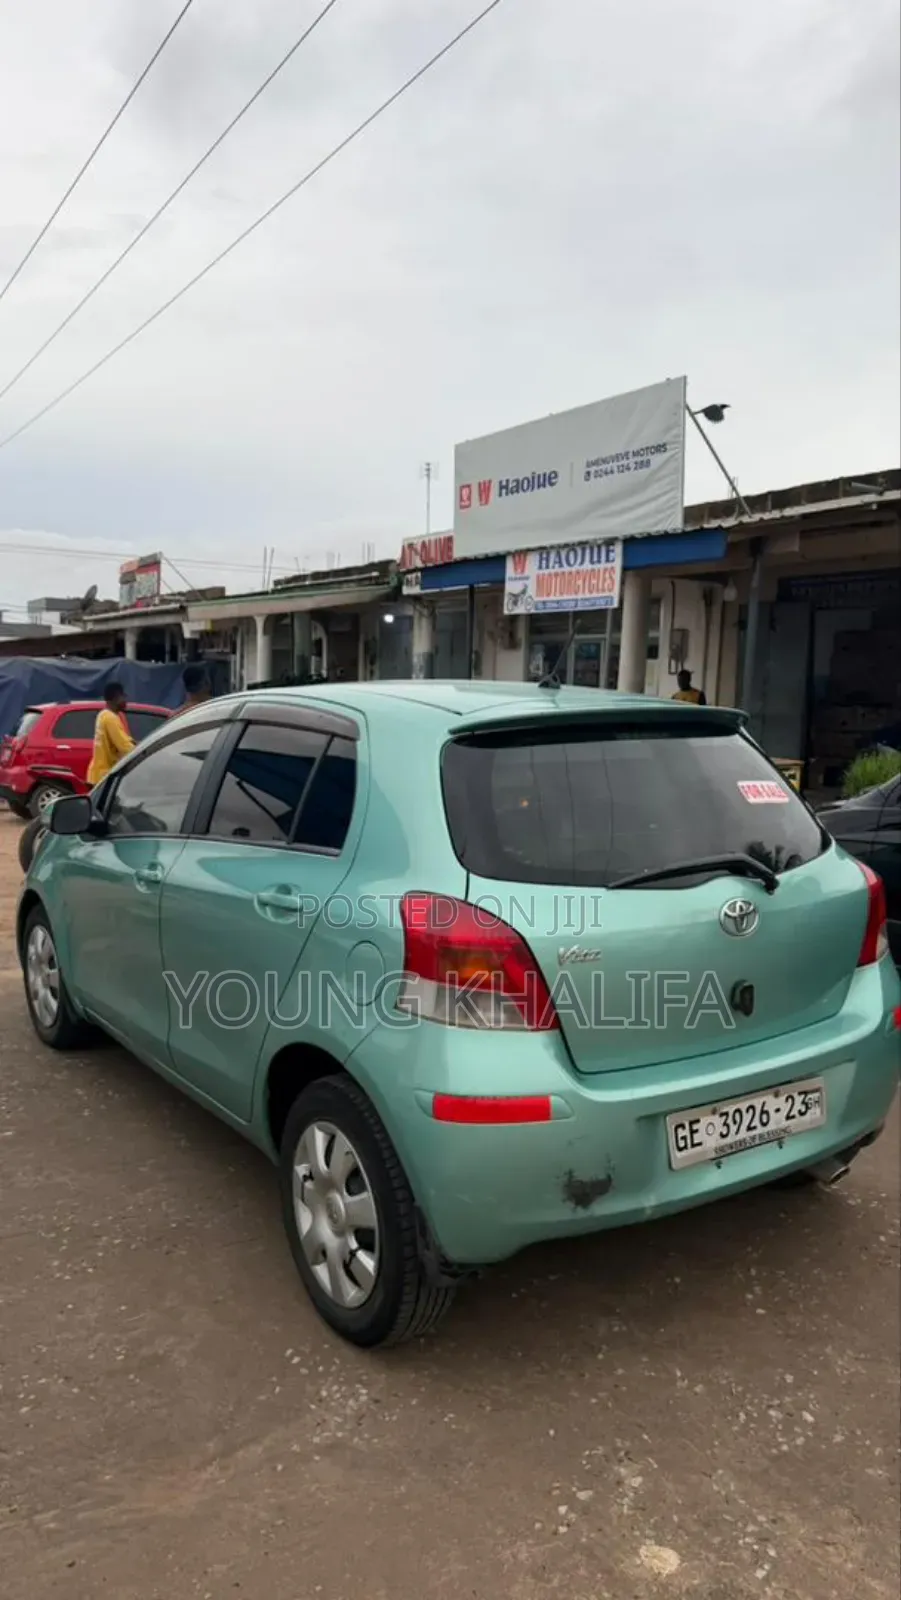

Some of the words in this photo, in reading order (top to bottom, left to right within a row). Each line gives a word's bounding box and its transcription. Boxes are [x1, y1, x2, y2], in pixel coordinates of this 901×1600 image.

[632, 443, 667, 458] MOTORS
[498, 470, 559, 498] Haojue
[537, 544, 616, 570] HAOJUE
[535, 567, 616, 597] MOTORCYCLES
[673, 1119, 703, 1152] GE
